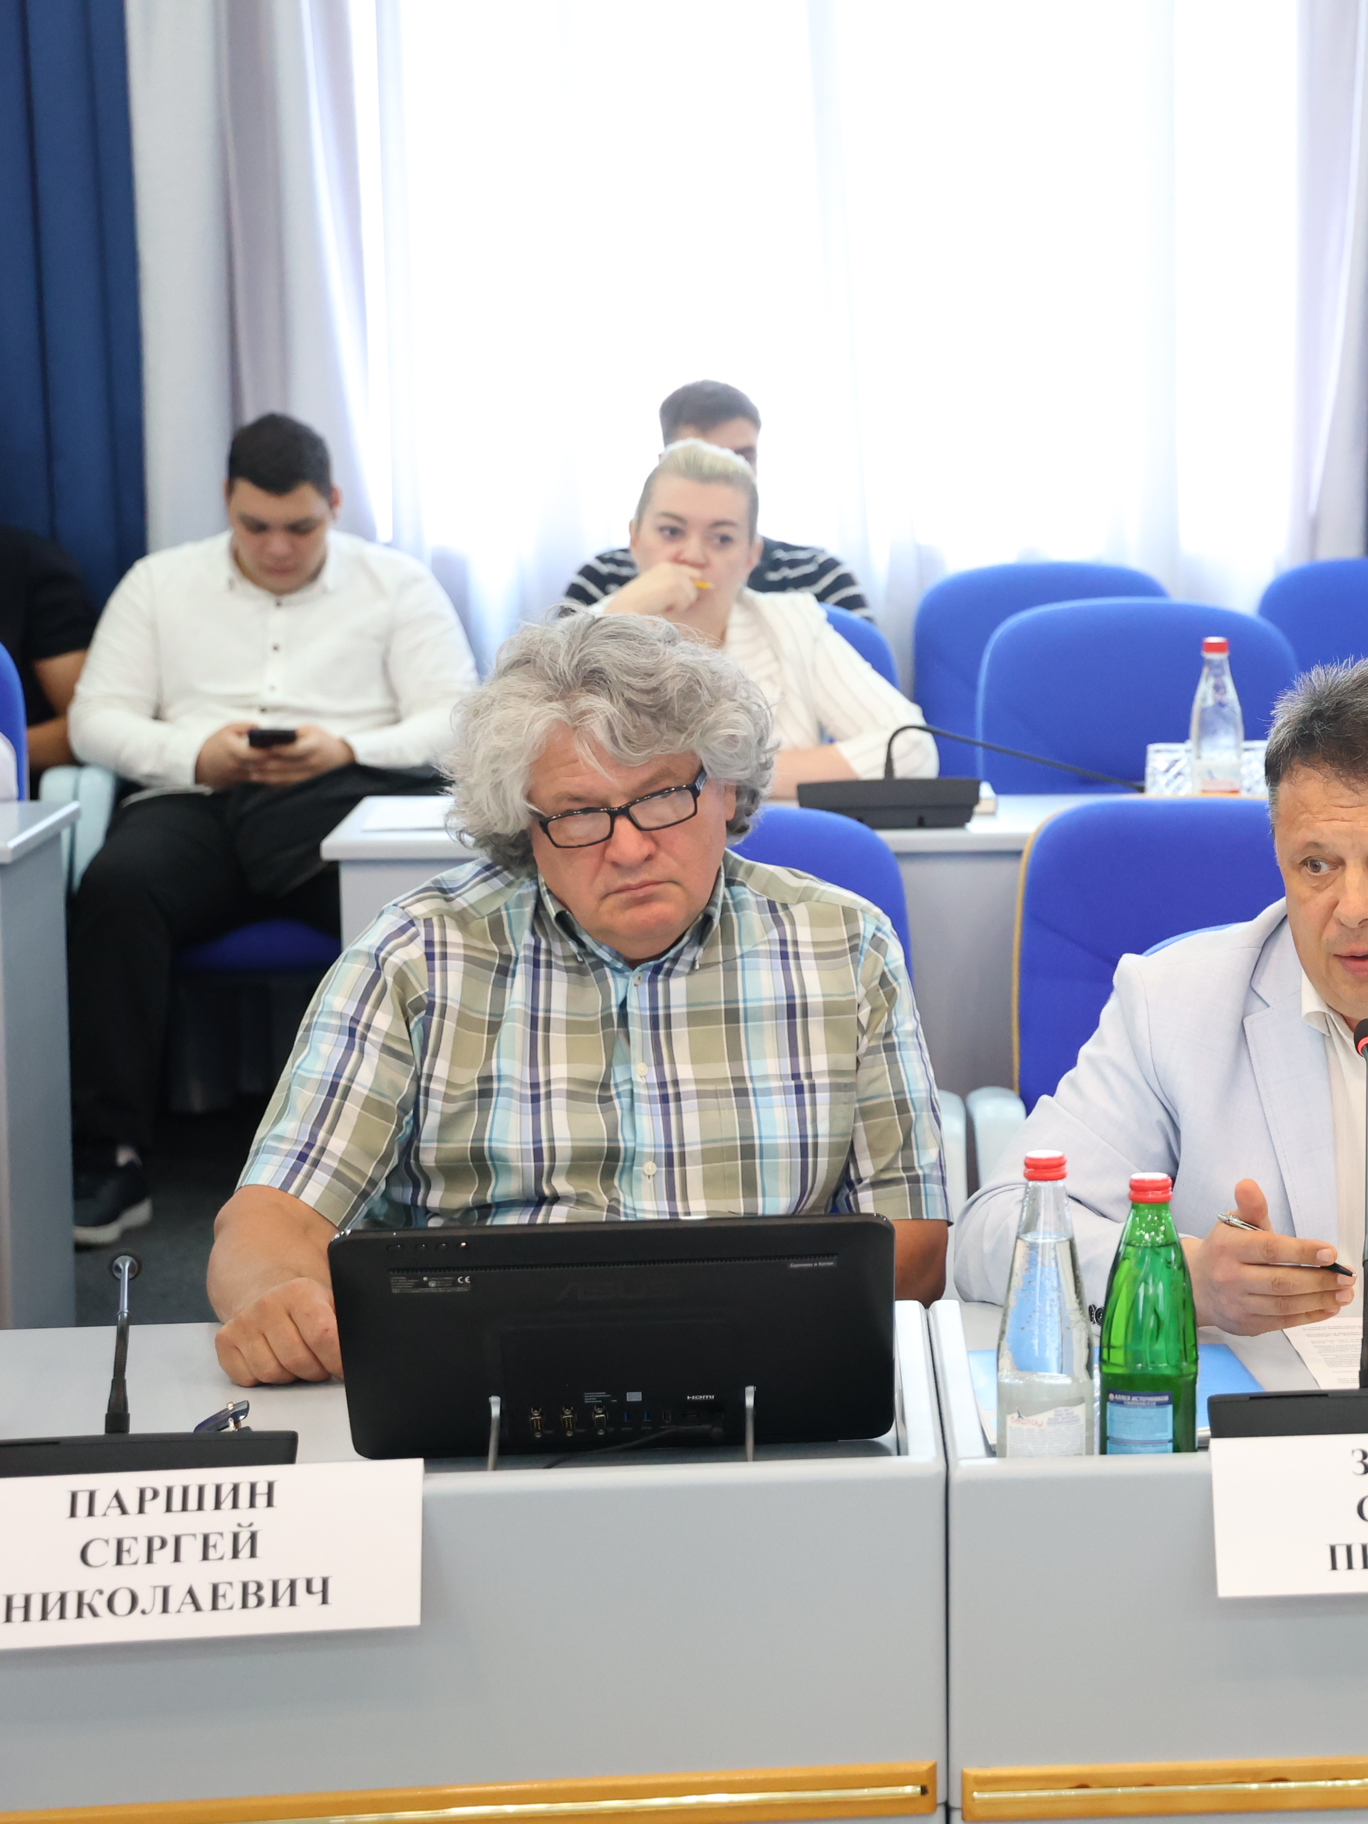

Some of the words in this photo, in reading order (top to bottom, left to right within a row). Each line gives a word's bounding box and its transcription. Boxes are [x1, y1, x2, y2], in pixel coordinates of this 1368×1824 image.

[66, 1480, 278, 1518] ПАРШИН
[79, 1522, 261, 1568] СЕРГЕЙ
[2, 1576, 332, 1623] НИКОЛАЕВИЧ
